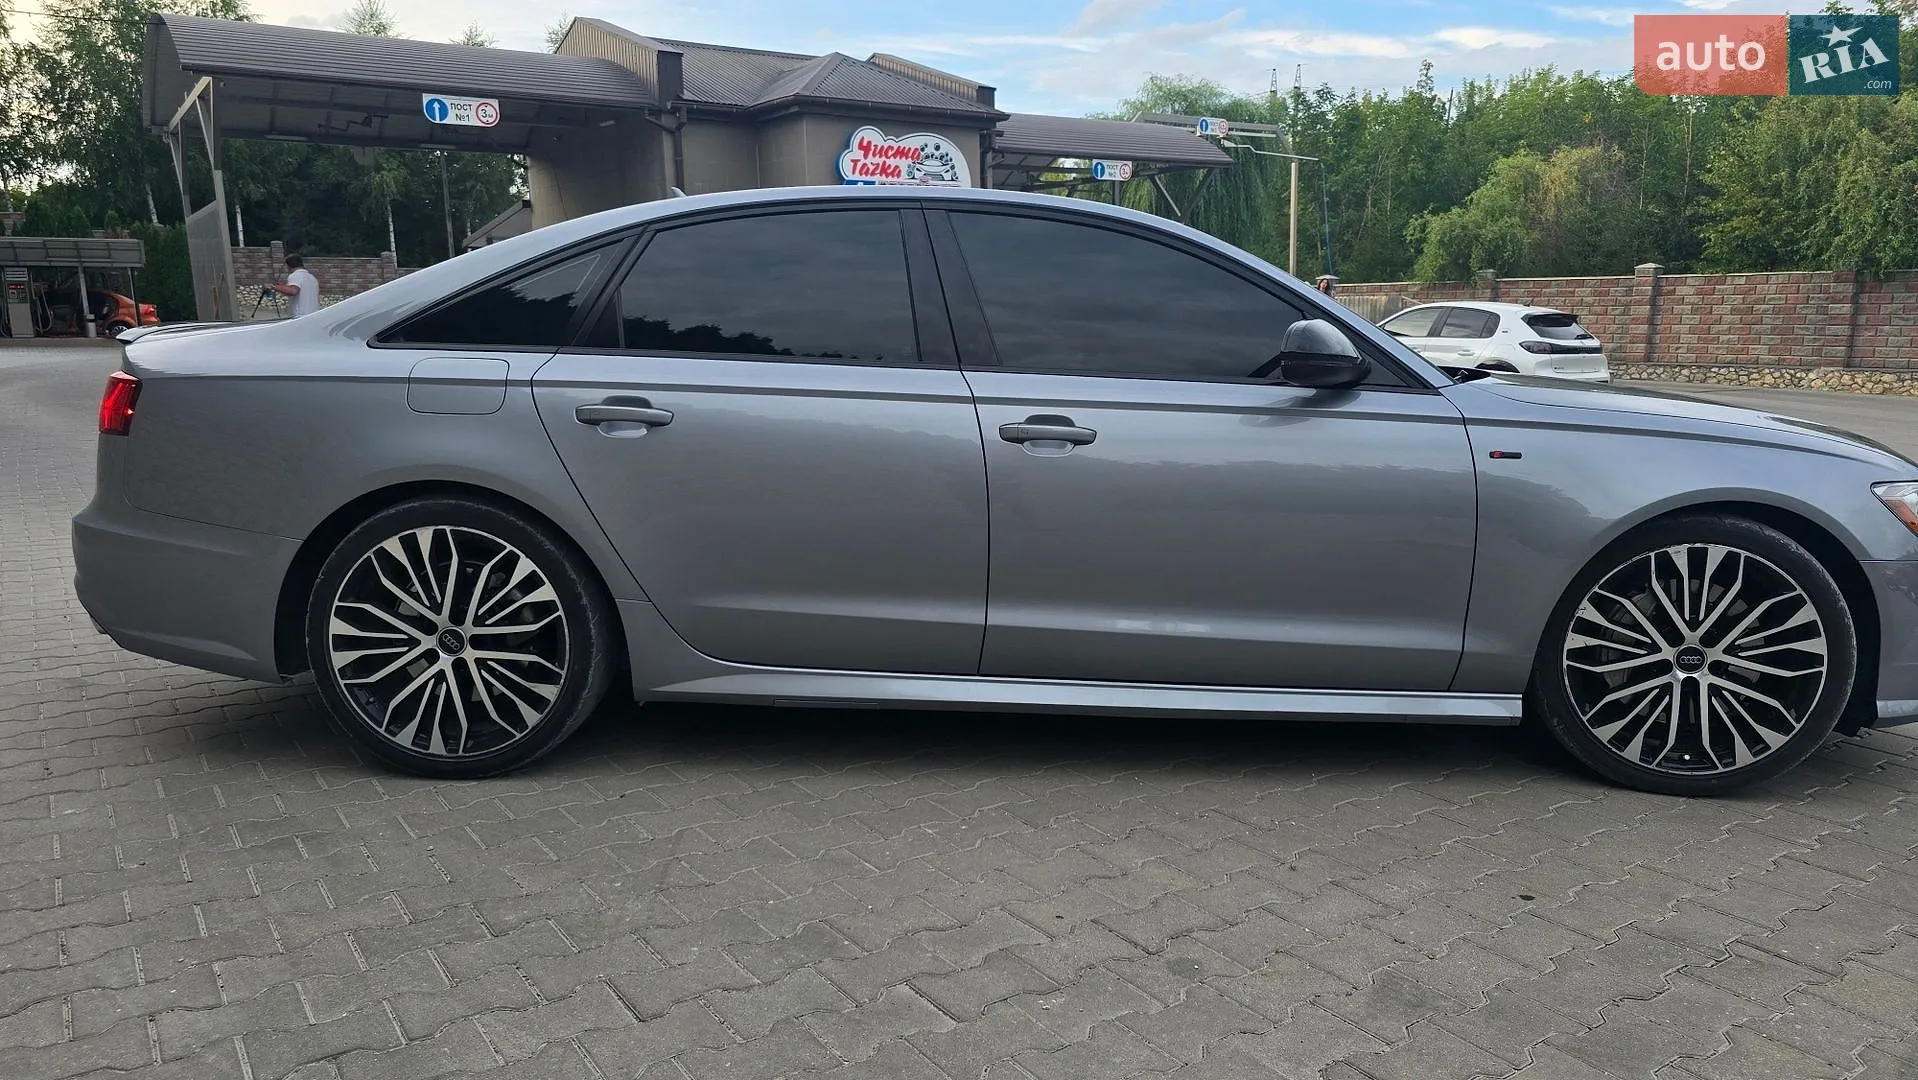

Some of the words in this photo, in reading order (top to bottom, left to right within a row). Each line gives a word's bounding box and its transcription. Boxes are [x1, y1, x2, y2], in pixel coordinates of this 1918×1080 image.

[450, 103, 472, 111] ПОСТ
[455, 114, 470, 122] №1
[857, 136, 921, 161] Чиста
